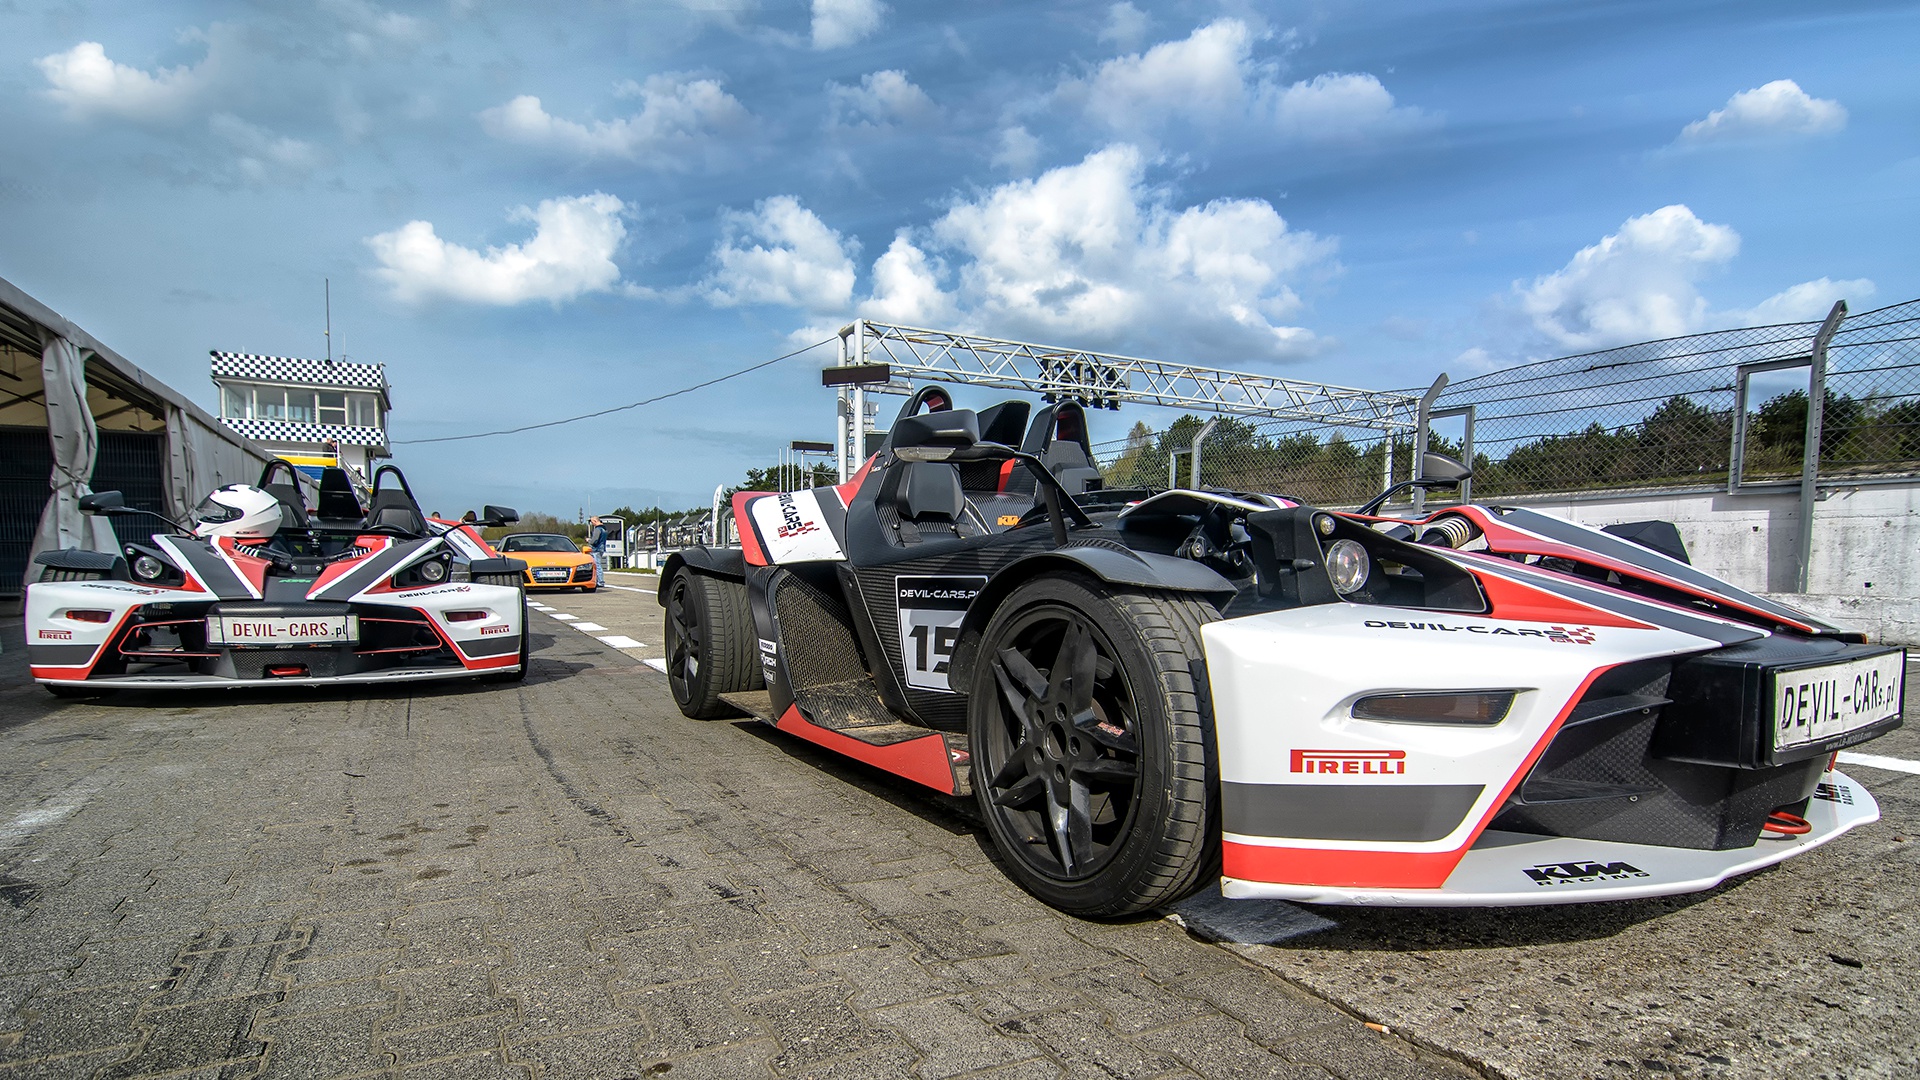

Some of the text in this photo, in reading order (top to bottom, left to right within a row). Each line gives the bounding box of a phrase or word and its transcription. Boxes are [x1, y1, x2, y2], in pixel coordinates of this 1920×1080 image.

[778, 492, 803, 531] EVIL-CARS
[39, 630, 72, 640] PIRELLI
[481, 625, 510, 635] PIRELLI
[1364, 619, 1570, 640] DEVIL-CARS
[1289, 749, 1406, 774] PIRELLI
[1522, 860, 1643, 881] KTM
[1535, 872, 1651, 887] RACING
